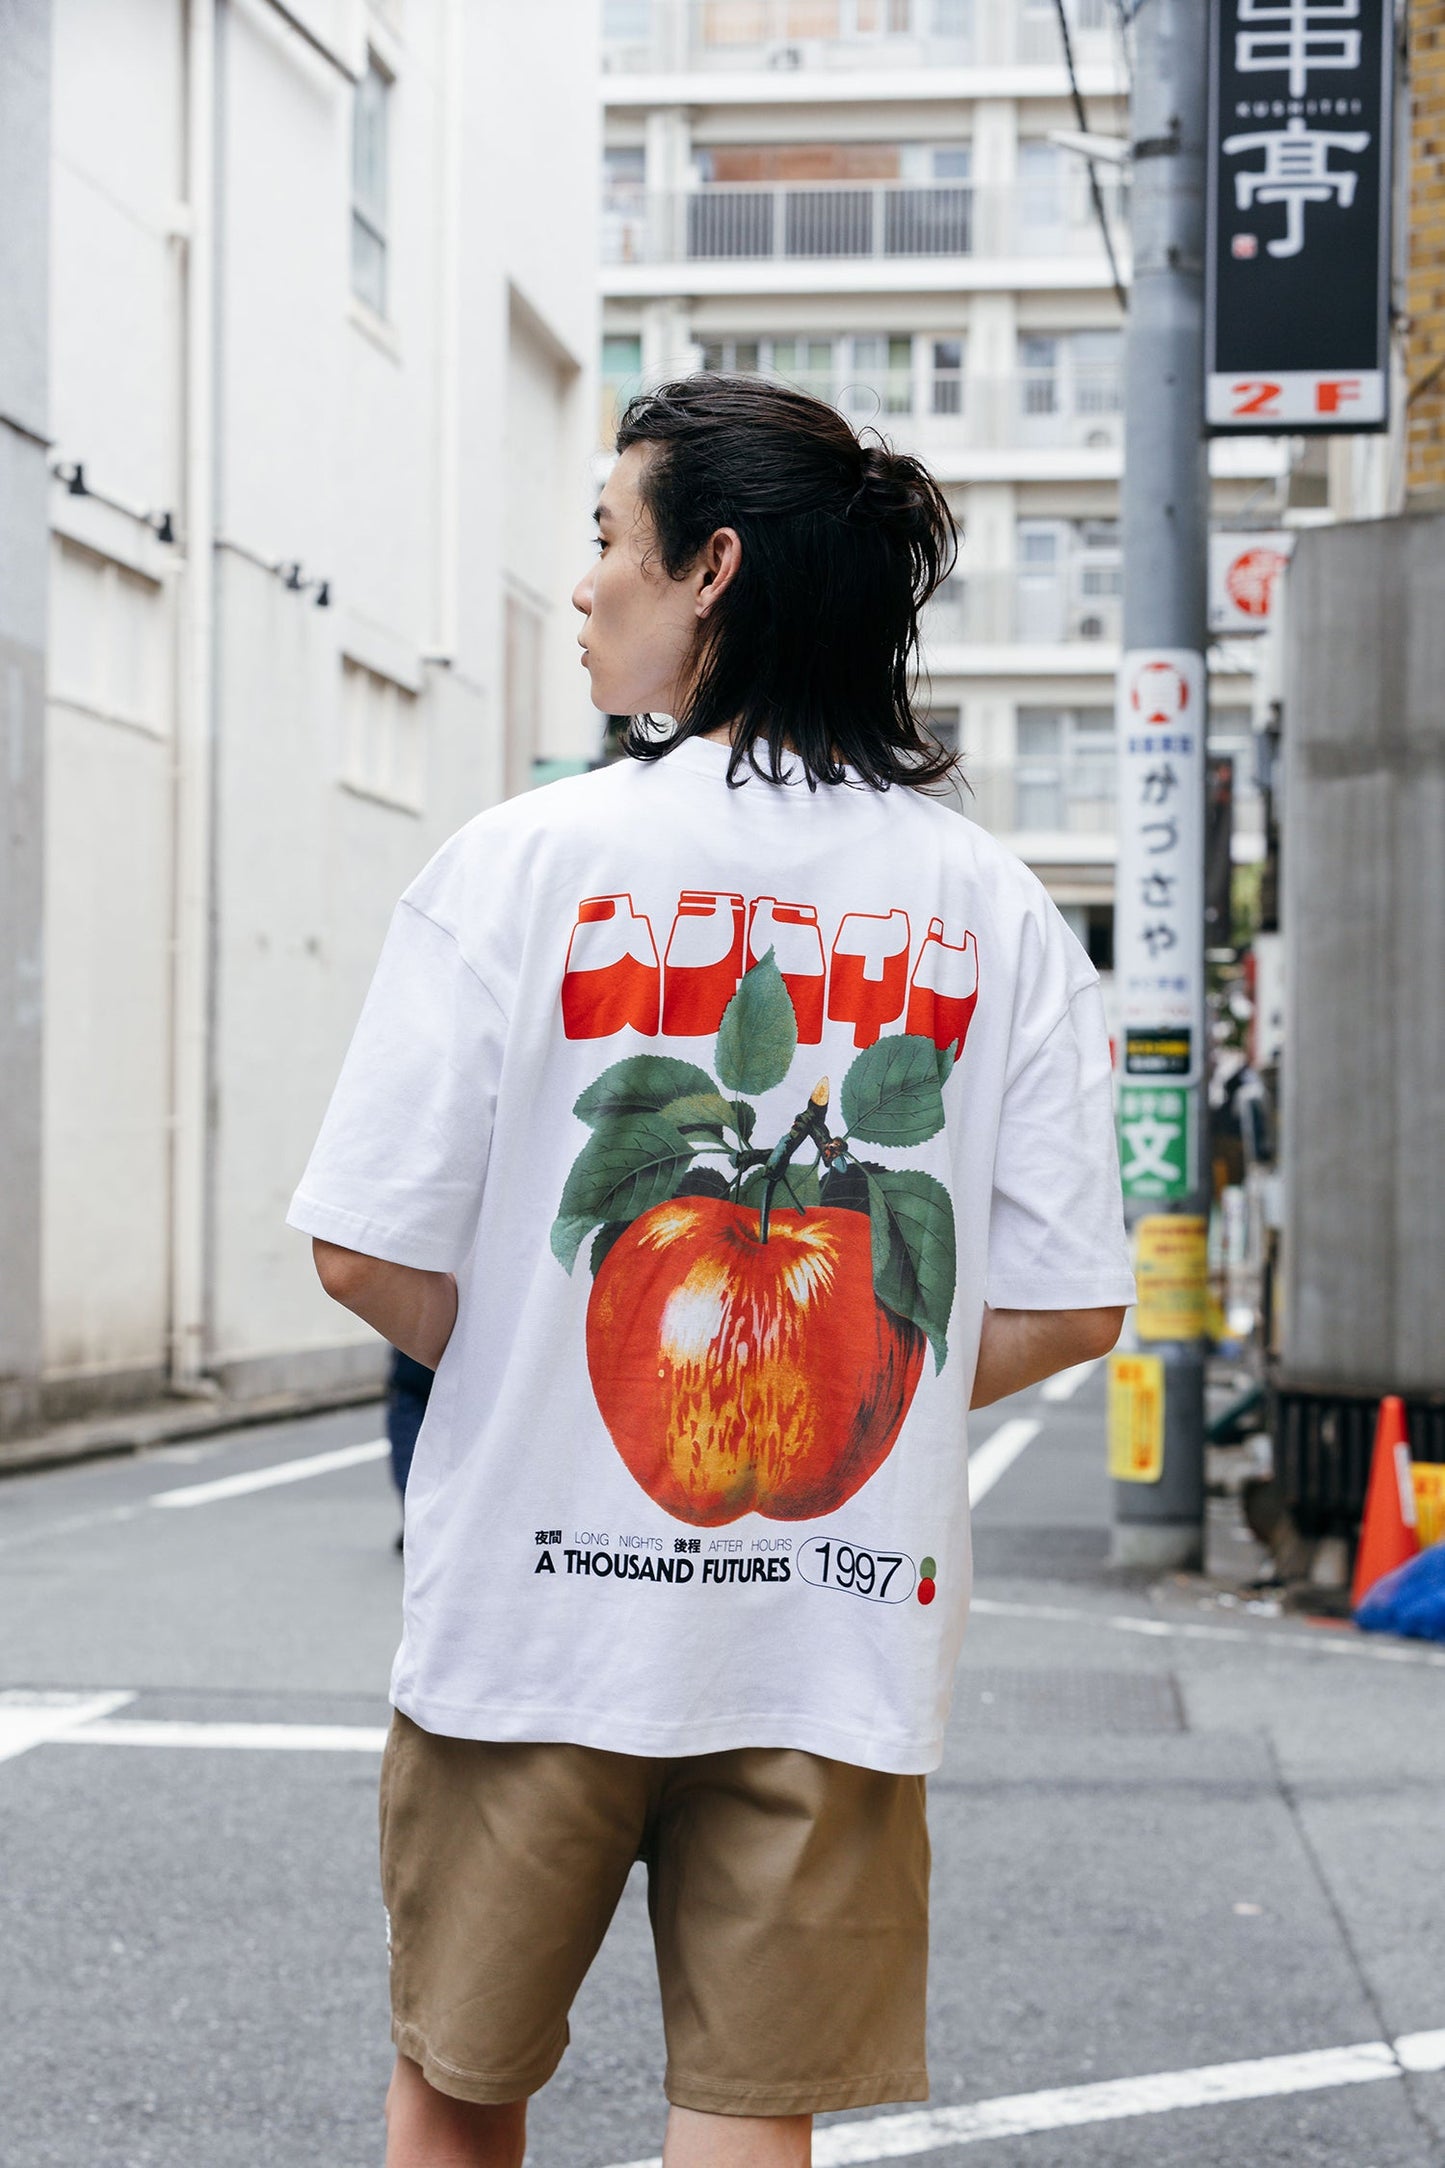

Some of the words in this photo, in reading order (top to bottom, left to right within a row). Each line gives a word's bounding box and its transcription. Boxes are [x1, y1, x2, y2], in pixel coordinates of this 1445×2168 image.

[1121, 1115, 1182, 1181] 文
[535, 1530, 562, 1545] 夜間
[574, 1531, 609, 1546] LONG
[619, 1535, 663, 1551] NIGHTS
[673, 1538, 701, 1554] 後程
[709, 1539, 743, 1552] AFTER
[752, 1538, 792, 1551] HOURS
[534, 1551, 556, 1574] A
[563, 1549, 694, 1584] THOUSAND
[702, 1557, 791, 1583] FUTURES
[815, 1541, 902, 1597] 1997
